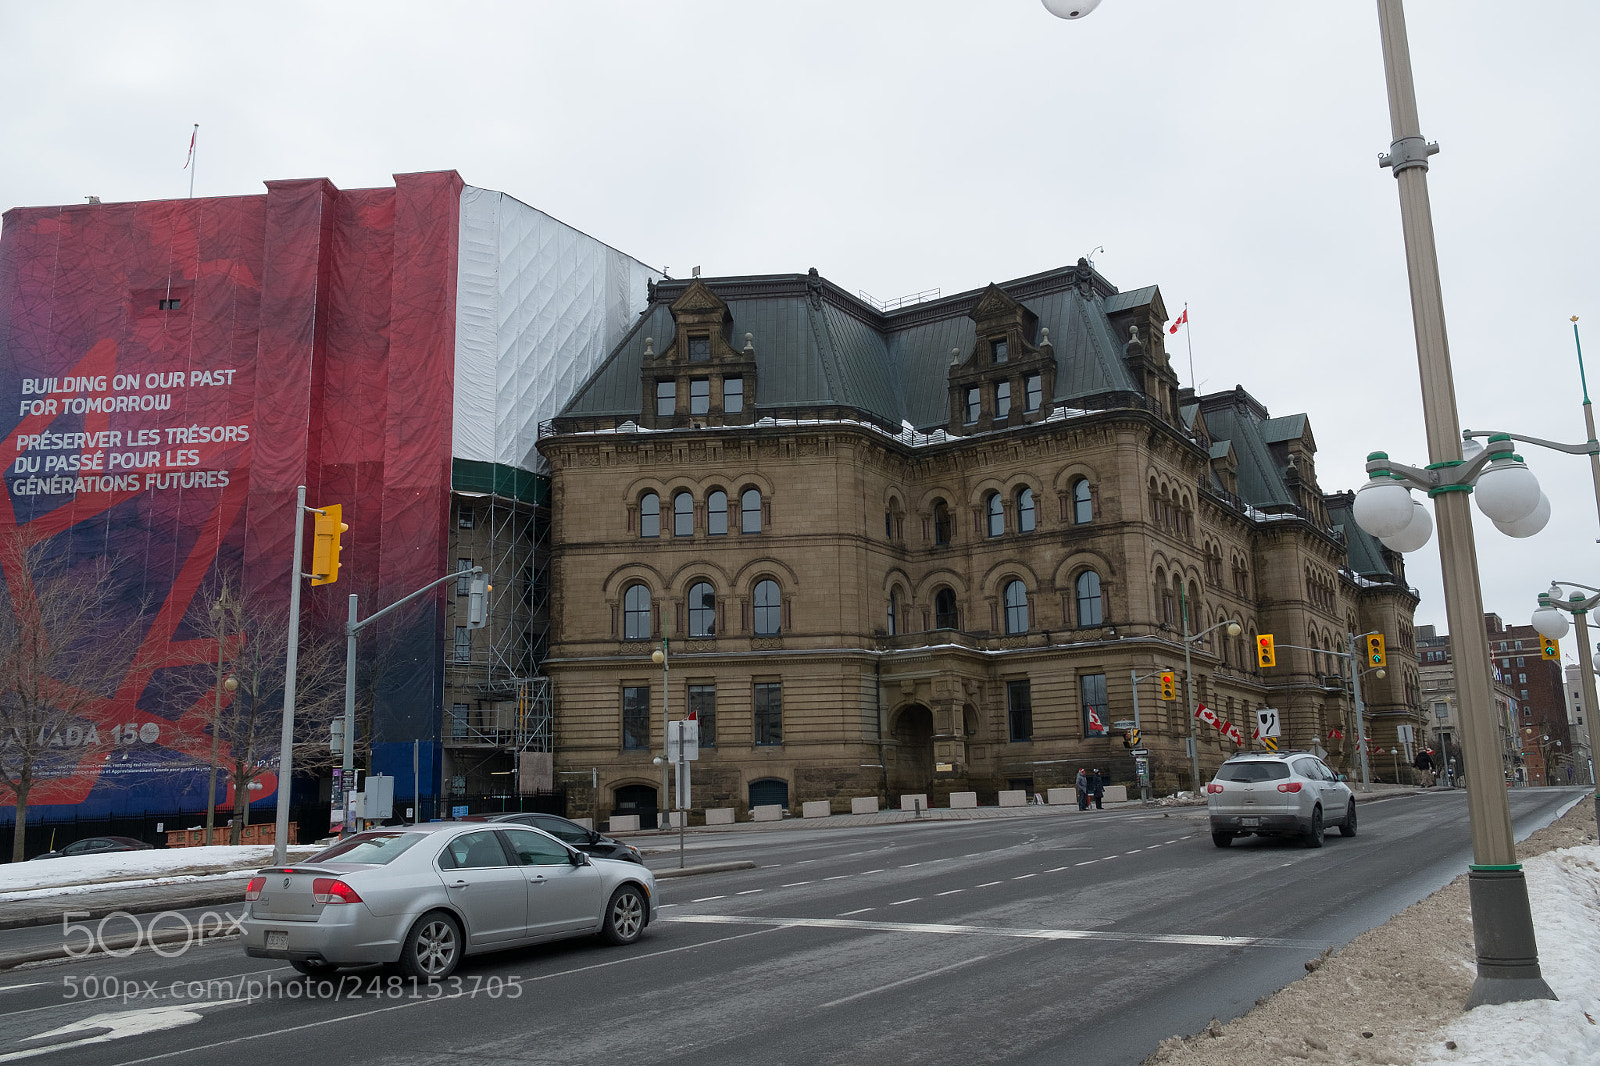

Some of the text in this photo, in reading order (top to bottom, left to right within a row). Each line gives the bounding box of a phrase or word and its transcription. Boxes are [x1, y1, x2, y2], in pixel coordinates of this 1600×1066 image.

[21, 369, 237, 395] BUILDING ON OUR PAST
[19, 393, 171, 416] FOR TOMORROW
[16, 424, 250, 451] PRÉSERVER LES TRÉSORS
[14, 449, 200, 474] DU PASSÉ POUR LES
[13, 470, 230, 496] GÉNÉRATIONS FUTURES
